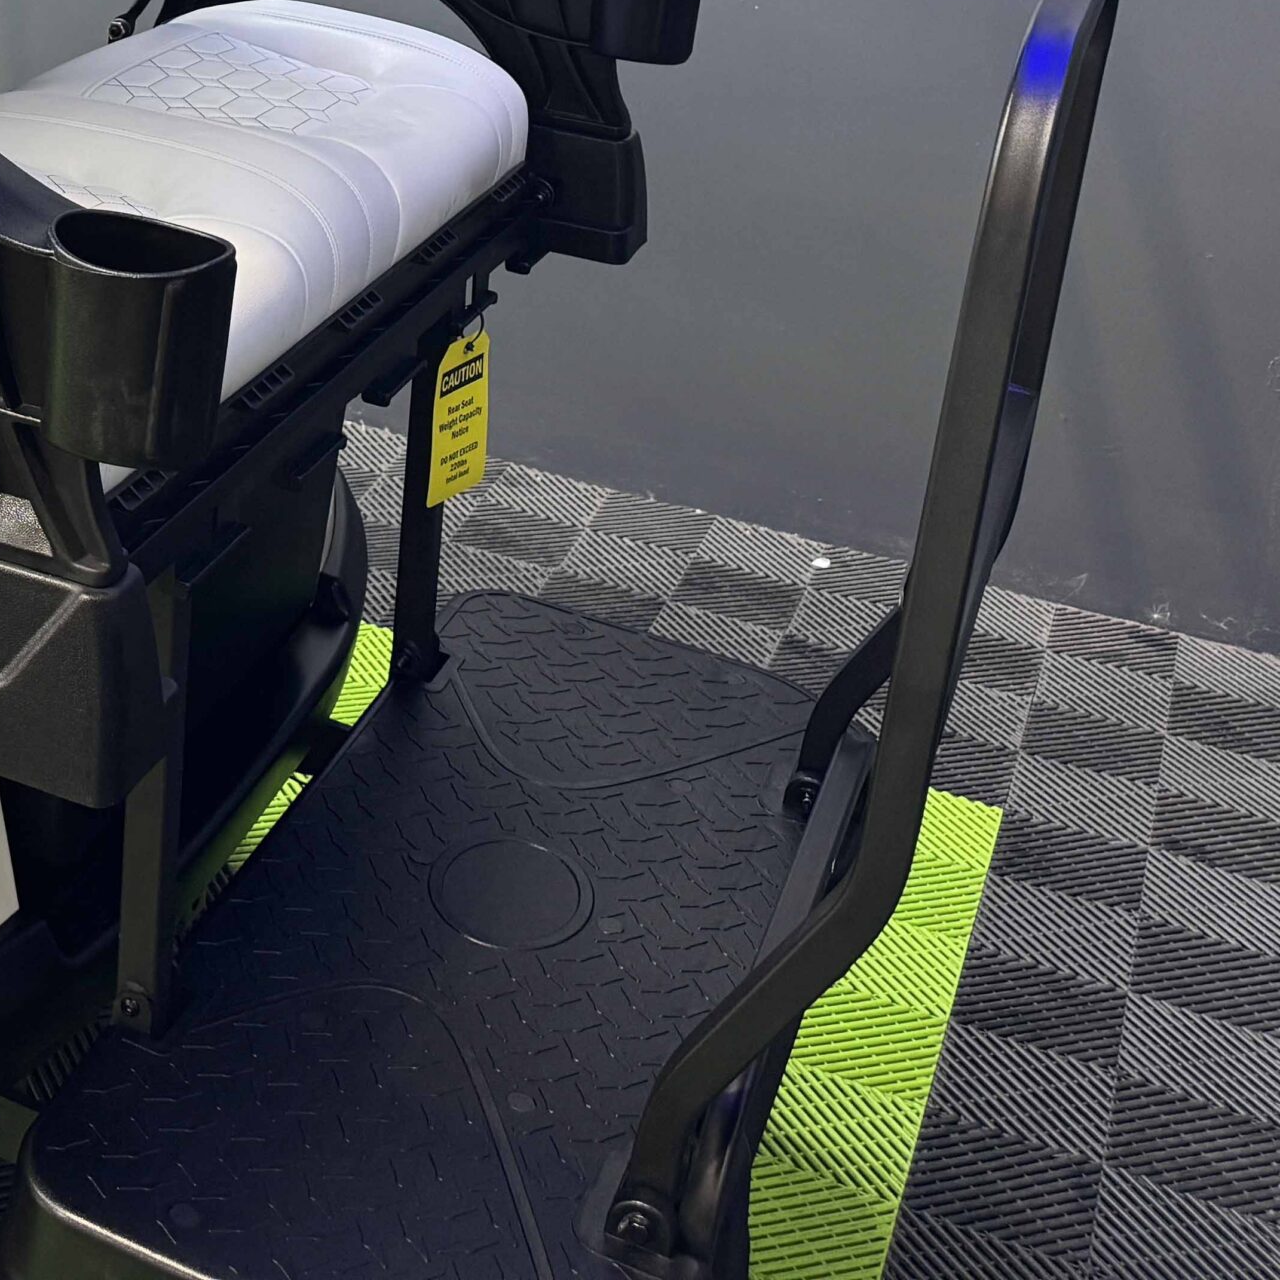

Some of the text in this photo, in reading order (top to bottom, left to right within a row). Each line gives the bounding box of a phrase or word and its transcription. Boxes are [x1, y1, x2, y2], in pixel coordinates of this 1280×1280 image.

[442, 358, 483, 392] CAUTION
[447, 395, 474, 416] Rear Seat
[439, 406, 482, 433] Weight Capacity
[451, 425, 469, 439] Notice
[440, 441, 478, 466] DO NOT EXCEED
